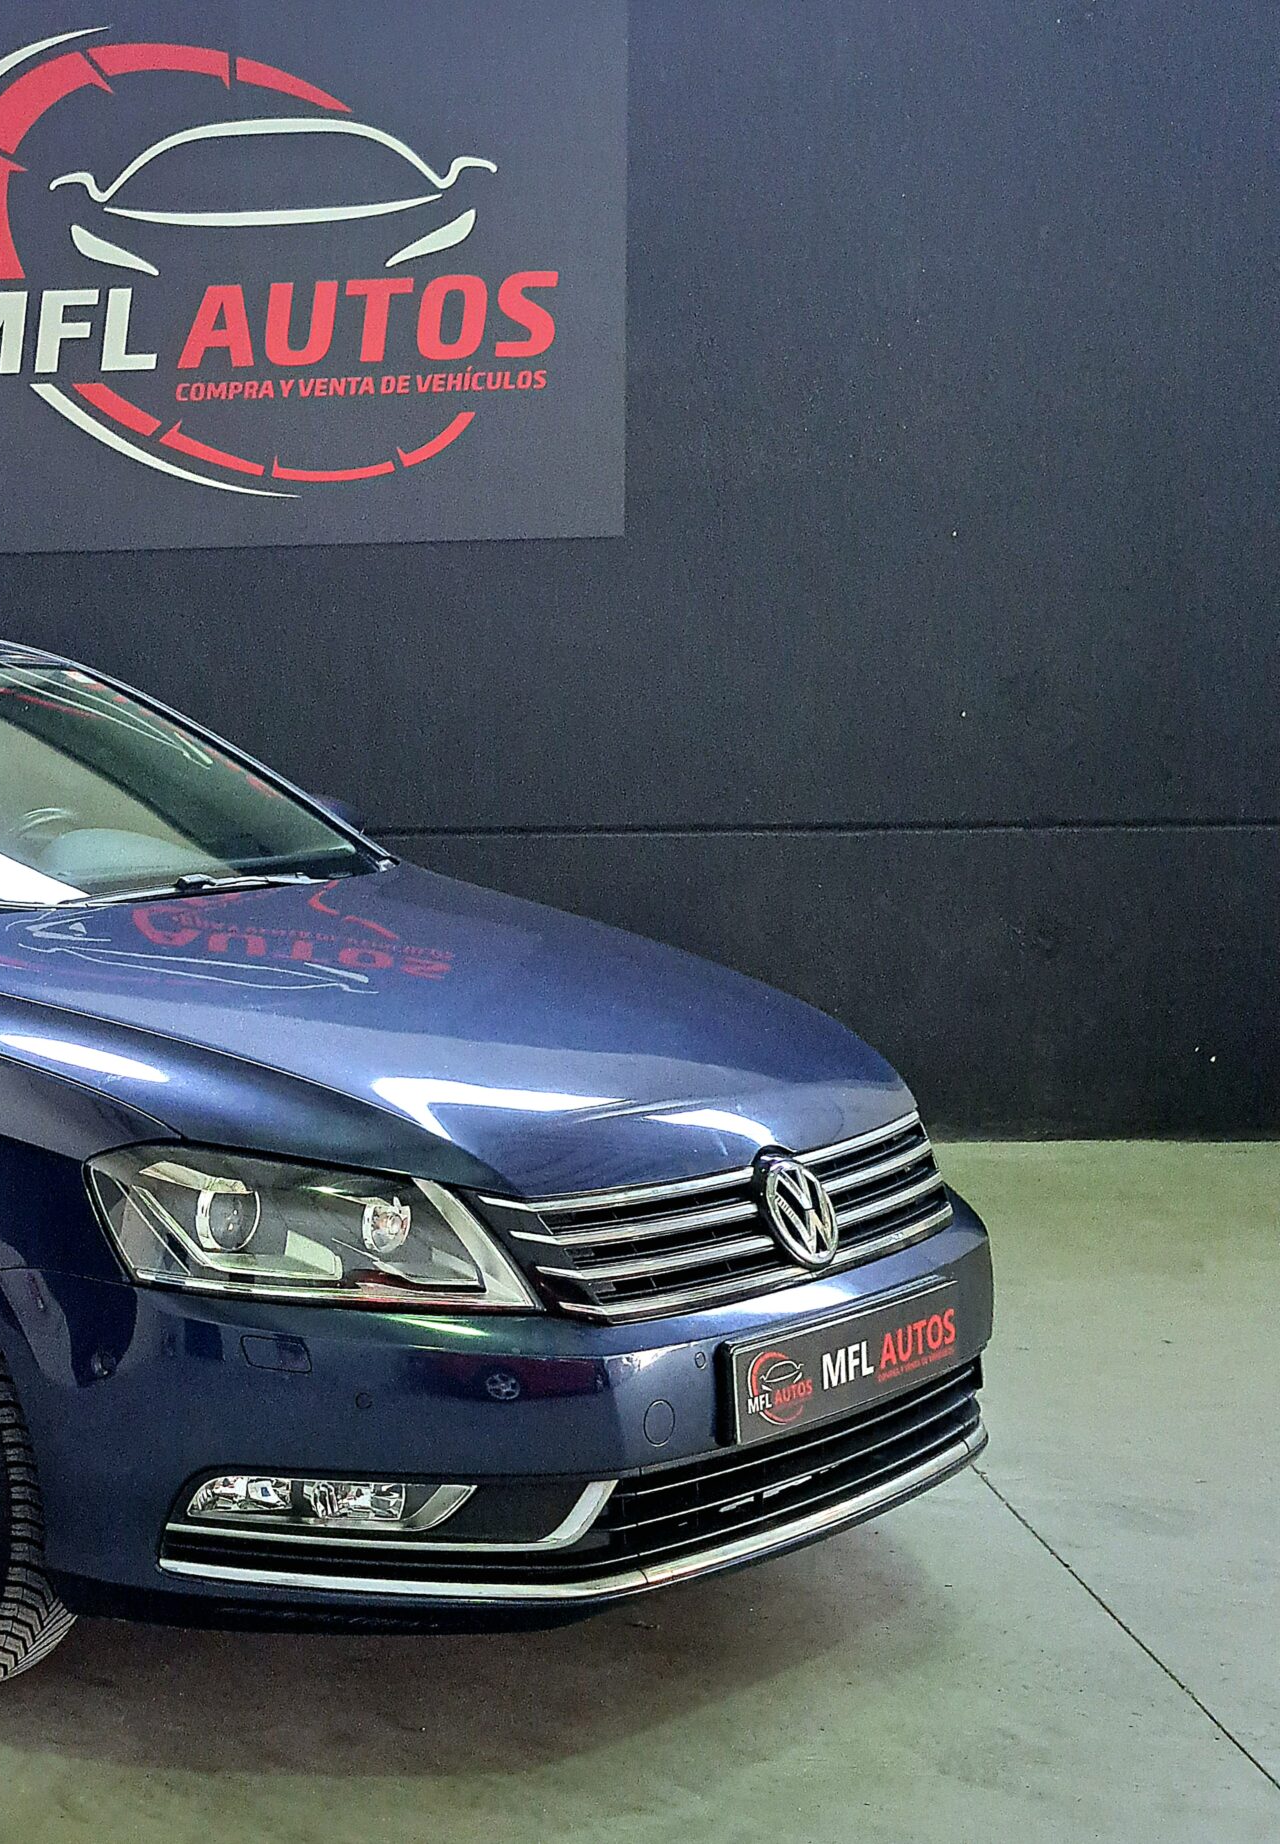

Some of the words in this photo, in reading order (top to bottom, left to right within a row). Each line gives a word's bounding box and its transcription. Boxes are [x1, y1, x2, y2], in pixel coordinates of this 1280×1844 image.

[176, 271, 559, 370] AUTOS
[175, 380, 273, 402] COMPRA
[280, 379, 293, 398] Y
[297, 376, 375, 398] VENTA
[380, 375, 410, 395] DE
[416, 366, 547, 393] VEHÍCULOS
[822, 1341, 875, 1390] MFL
[879, 1308, 956, 1370] AUTOS
[747, 1393, 773, 1415] MFL
[775, 1379, 813, 1406] AUTOS
